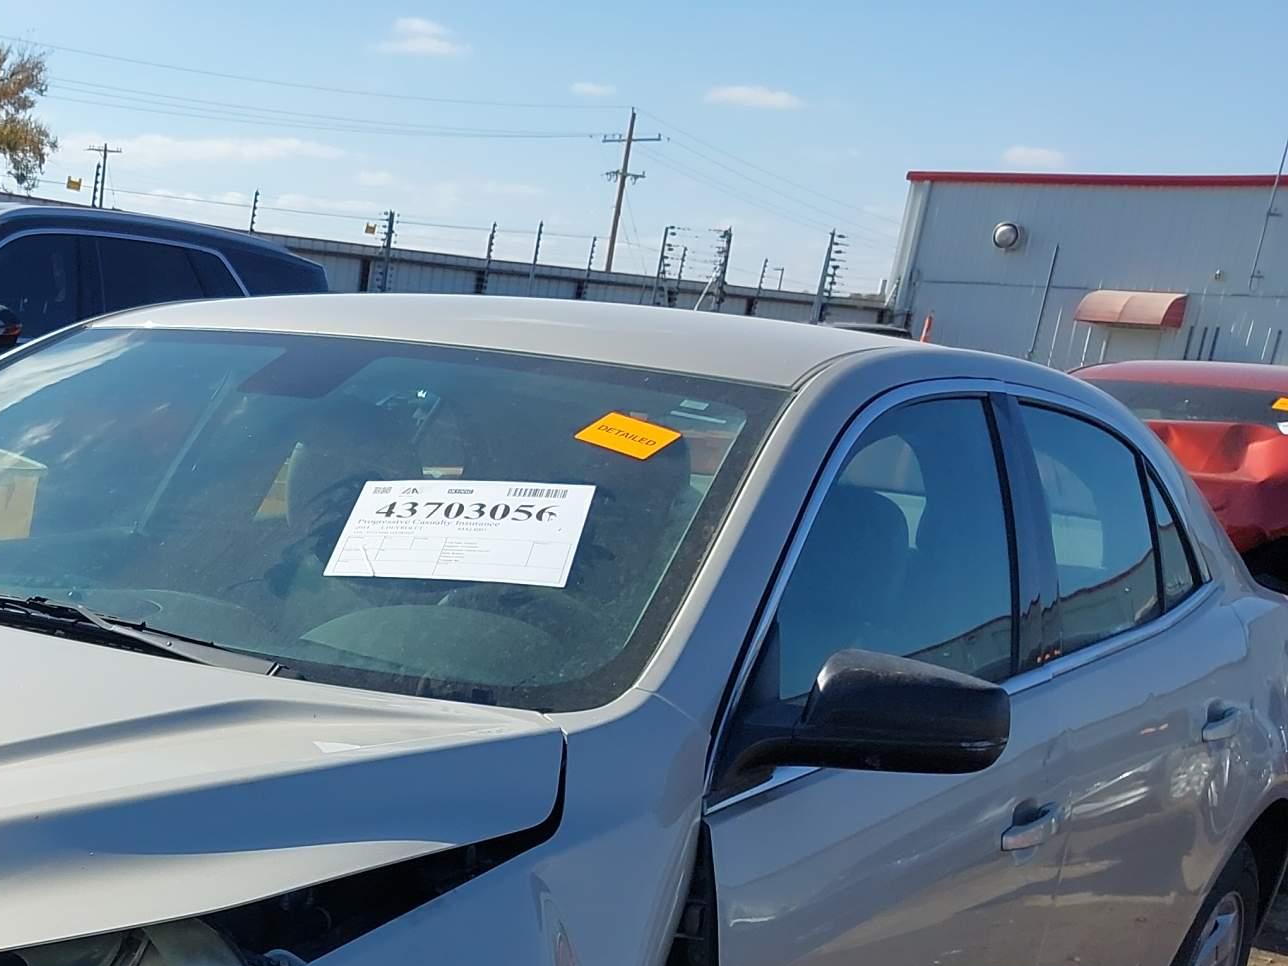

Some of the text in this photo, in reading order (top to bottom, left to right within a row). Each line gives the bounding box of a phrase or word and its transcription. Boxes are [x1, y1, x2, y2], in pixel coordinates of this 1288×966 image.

[597, 424, 657, 447] DETAILED
[375, 501, 560, 523] 43703056
[358, 519, 501, 528] Progressive Casualty Insurance
